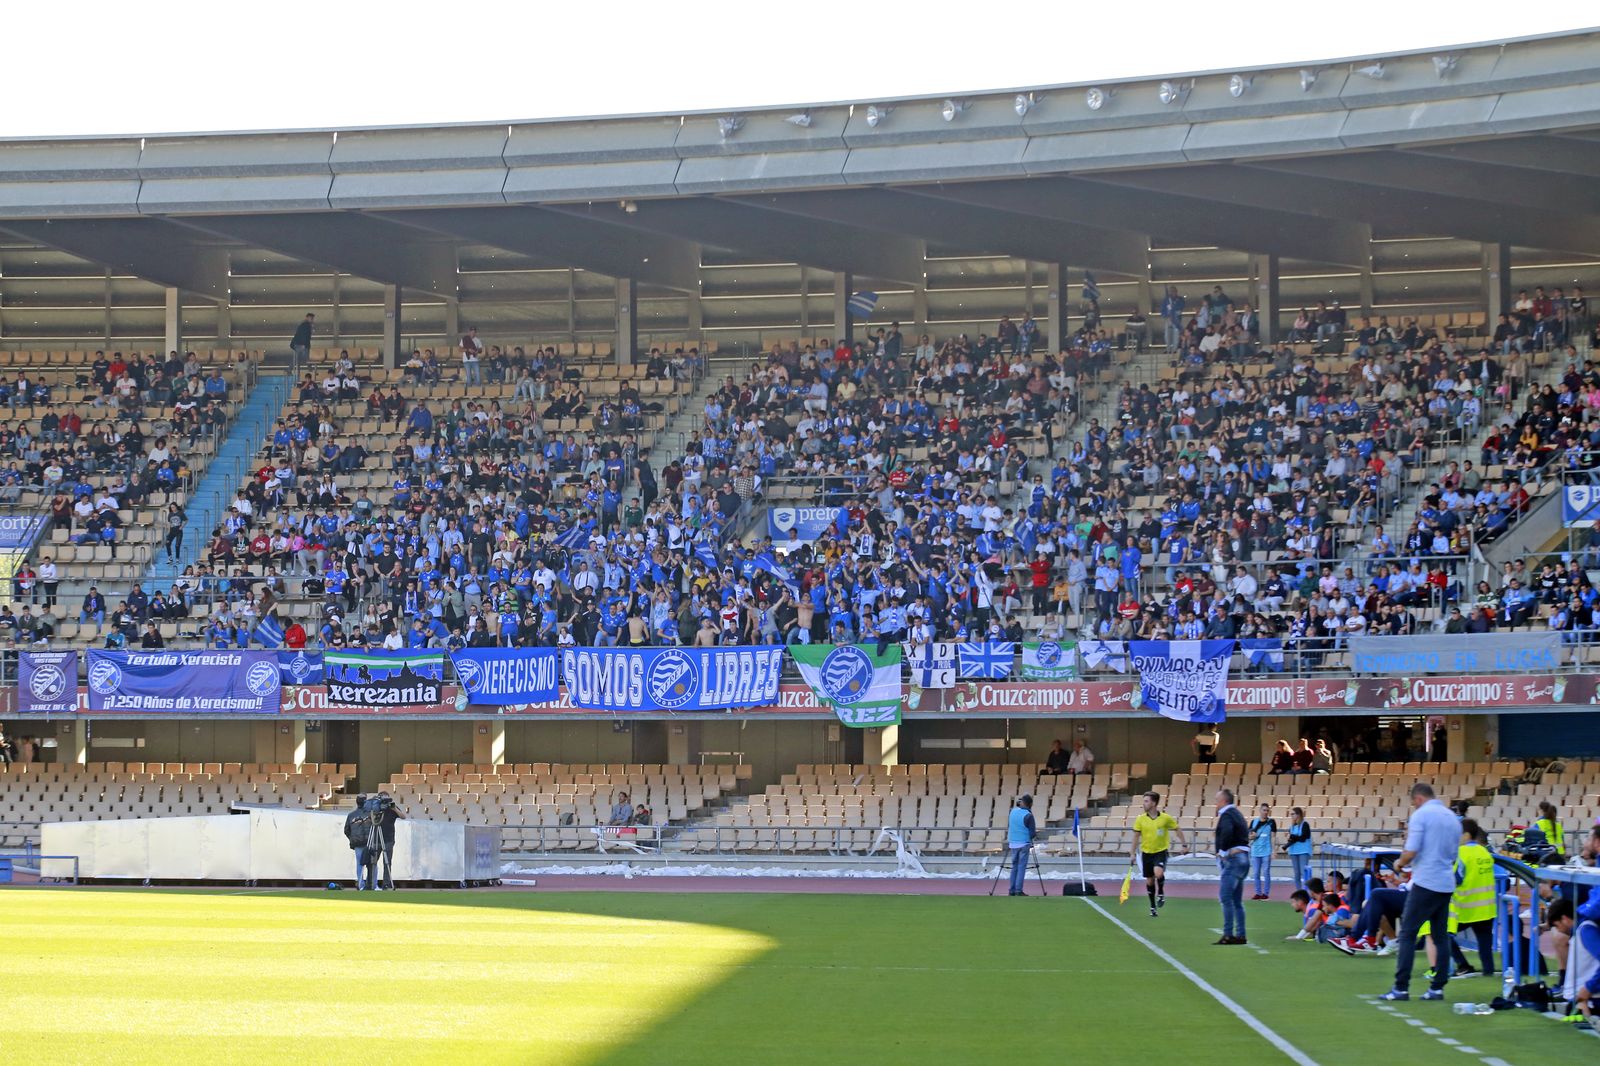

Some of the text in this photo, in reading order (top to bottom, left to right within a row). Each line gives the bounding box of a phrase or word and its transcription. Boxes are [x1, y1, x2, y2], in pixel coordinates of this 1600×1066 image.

[127, 654, 242, 666] Tertulia Xerecista
[940, 644, 947, 658] D
[1455, 653, 1477, 669] EN
[1495, 649, 1555, 669] LUCHA
[481, 655, 554, 695] XERECISMO
[563, 649, 782, 707] SOMOS LIBRES
[941, 672, 947, 685] C
[1024, 668, 1073, 678] XEREZ
[329, 683, 438, 704] xerezania
[981, 685, 1089, 709] Cruzcampo SIN
[1147, 684, 1198, 712] DELITO
[1297, 686, 1305, 703] SIN
[1413, 680, 1514, 704] Cruzcampo SIN
[143, 696, 174, 709] Años
[175, 697, 190, 709] de
[193, 697, 263, 710] Xerecismo!!
[837, 706, 897, 723] REZ
